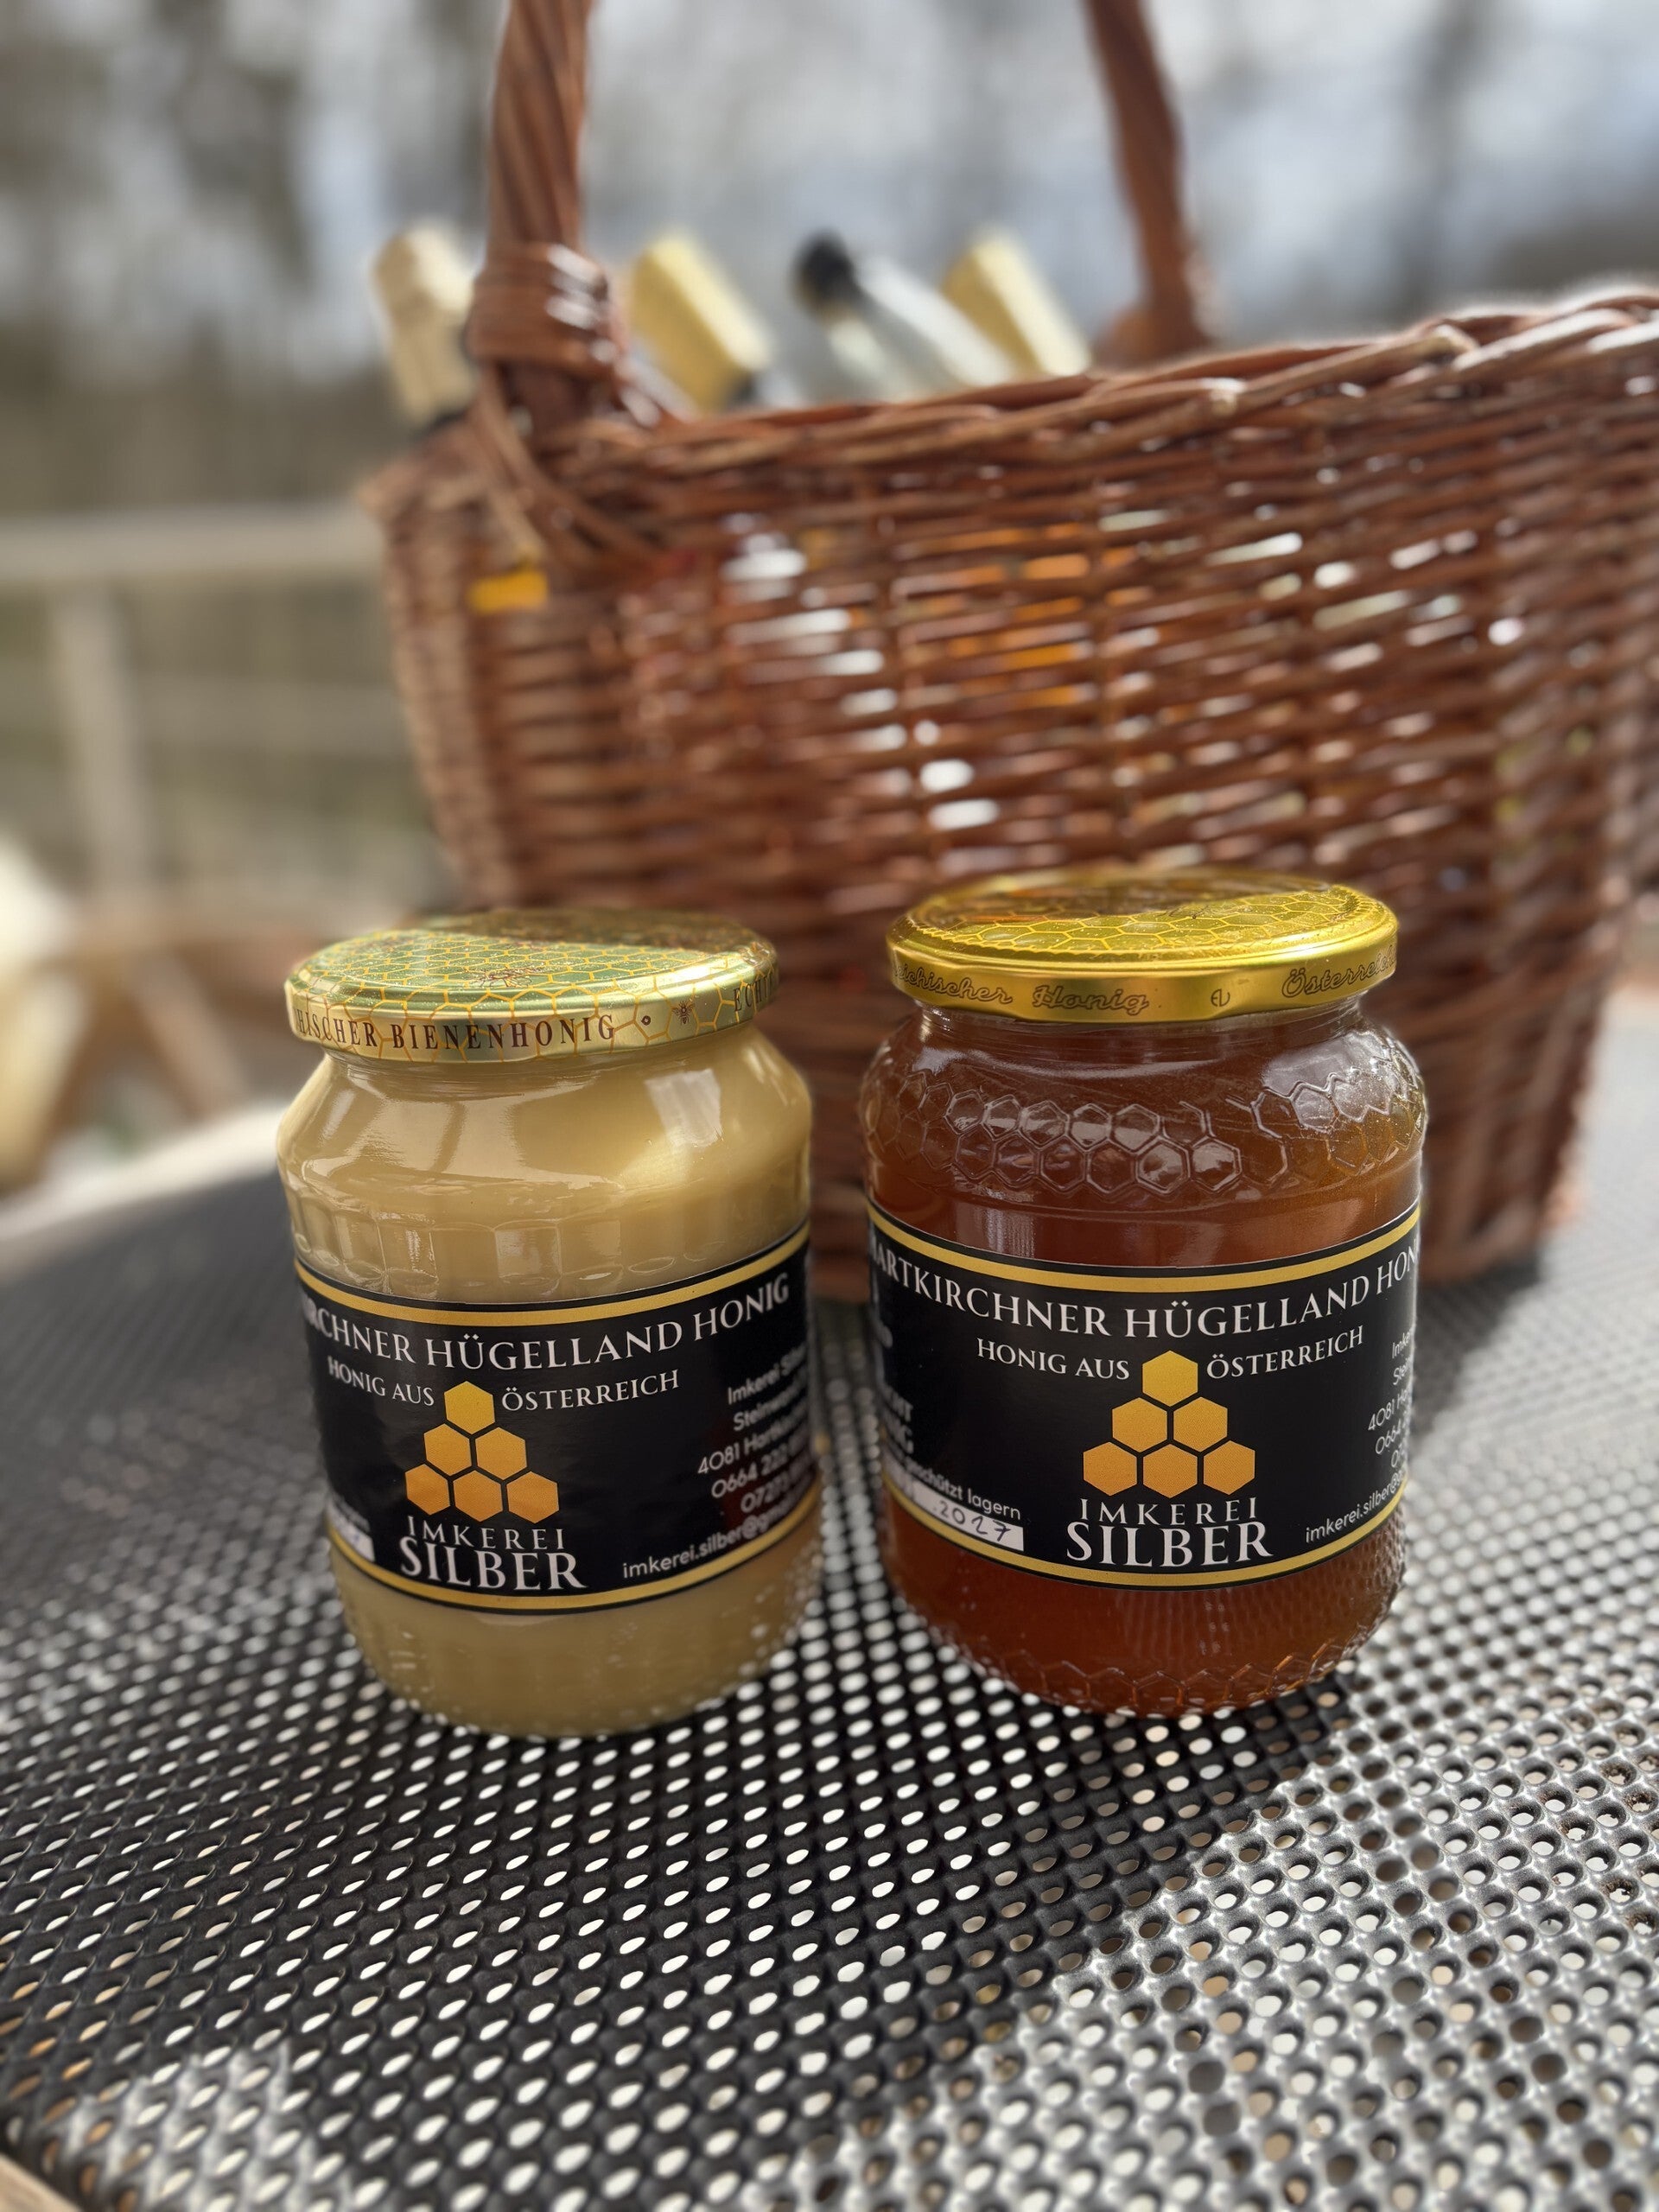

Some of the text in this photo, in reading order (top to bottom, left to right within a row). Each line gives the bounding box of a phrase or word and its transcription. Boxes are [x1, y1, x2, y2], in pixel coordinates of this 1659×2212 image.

[1033, 984, 1150, 1016] Honig
[295, 1007, 615, 1050] HISCHER BIENENHONIG
[425, 1321, 683, 1370] HÜGELLAND
[693, 1273, 790, 1341] HONIG
[1124, 1275, 1370, 1338] HÜGELLAND
[977, 1325, 1363, 1380] HONIG AUS ÖSTERREICH
[327, 1355, 679, 1412] HONIG AUS ÖSTERREICH
[1368, 1398, 1395, 1431] 4081
[698, 1442, 741, 1474] 4081
[712, 1461, 758, 1498] 0664
[968, 1488, 1020, 1520] lagern
[1080, 1497, 1256, 1526] IMKEREI
[407, 1516, 564, 1550] IMKEREI
[1066, 1521, 1274, 1567] SILBER
[399, 1535, 589, 1591] SILBER
